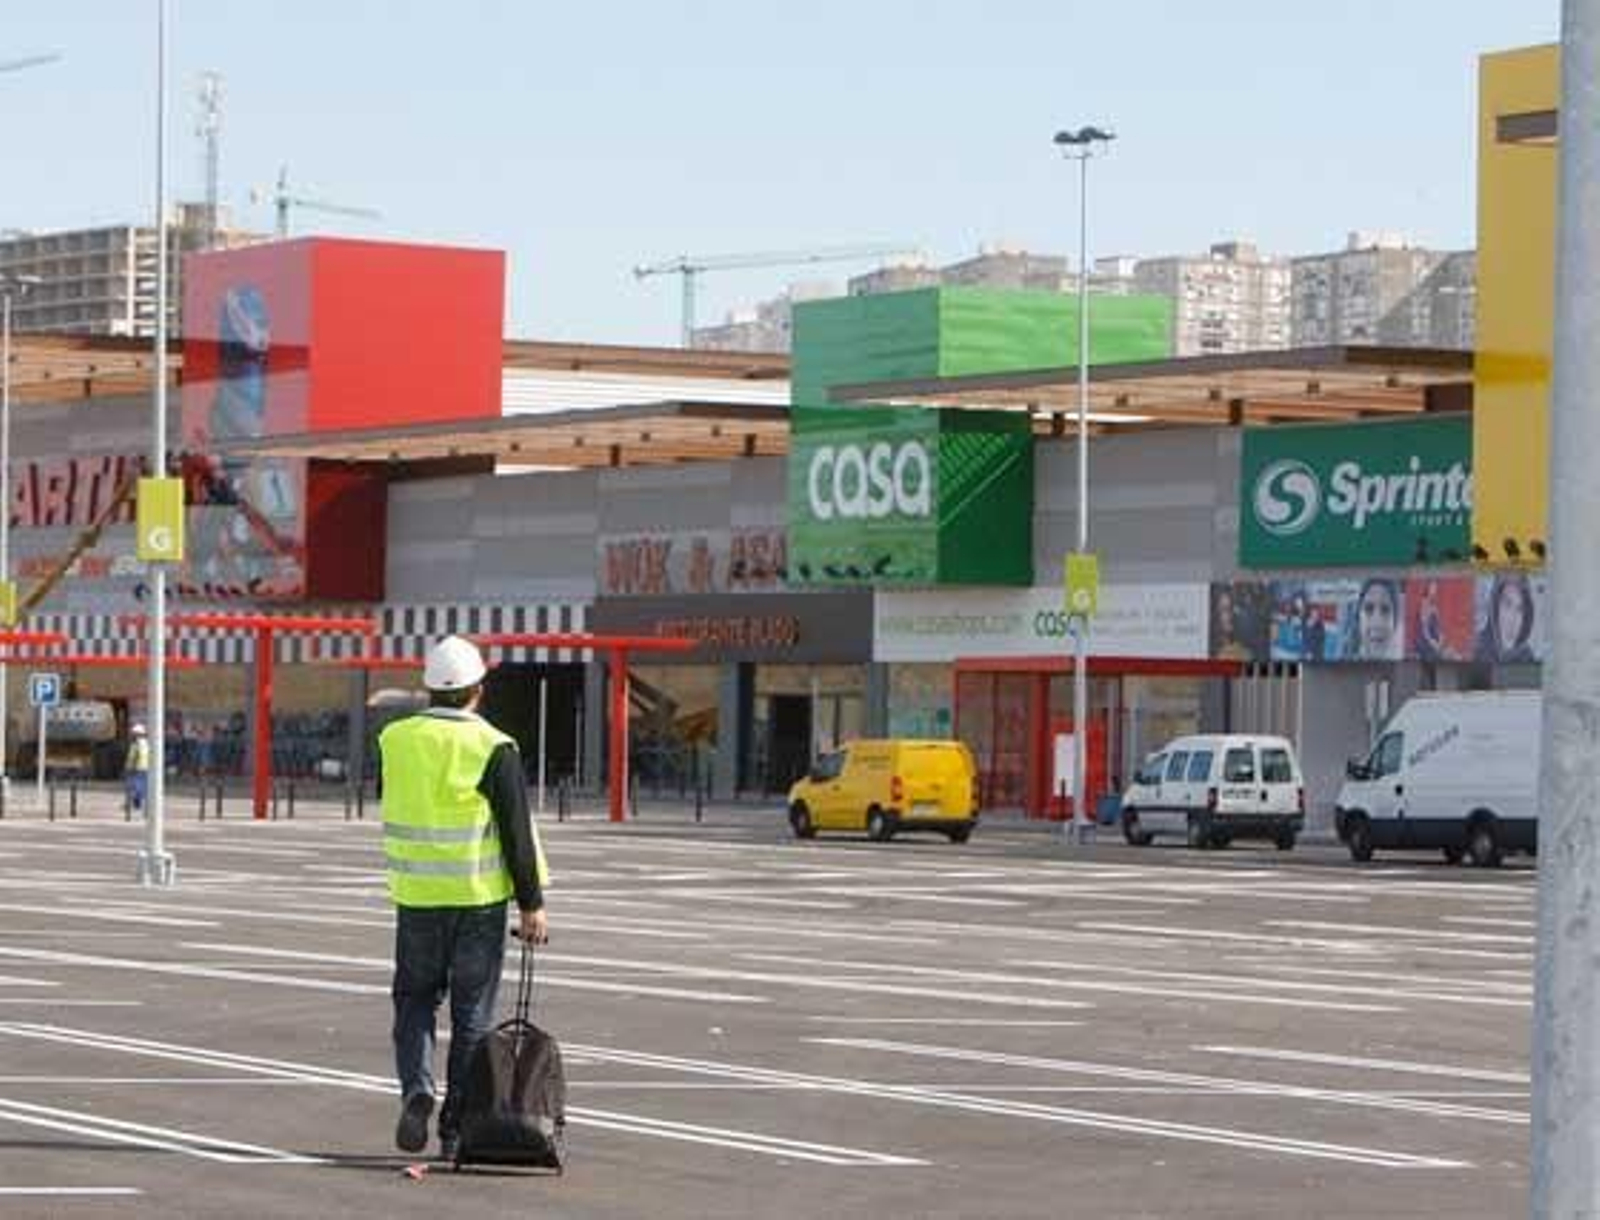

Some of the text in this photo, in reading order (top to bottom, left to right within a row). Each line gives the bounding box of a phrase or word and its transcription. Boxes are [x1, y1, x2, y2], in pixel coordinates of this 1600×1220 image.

[808, 441, 932, 519] casa
[148, 526, 172, 551] G
[37, 679, 52, 701] P
